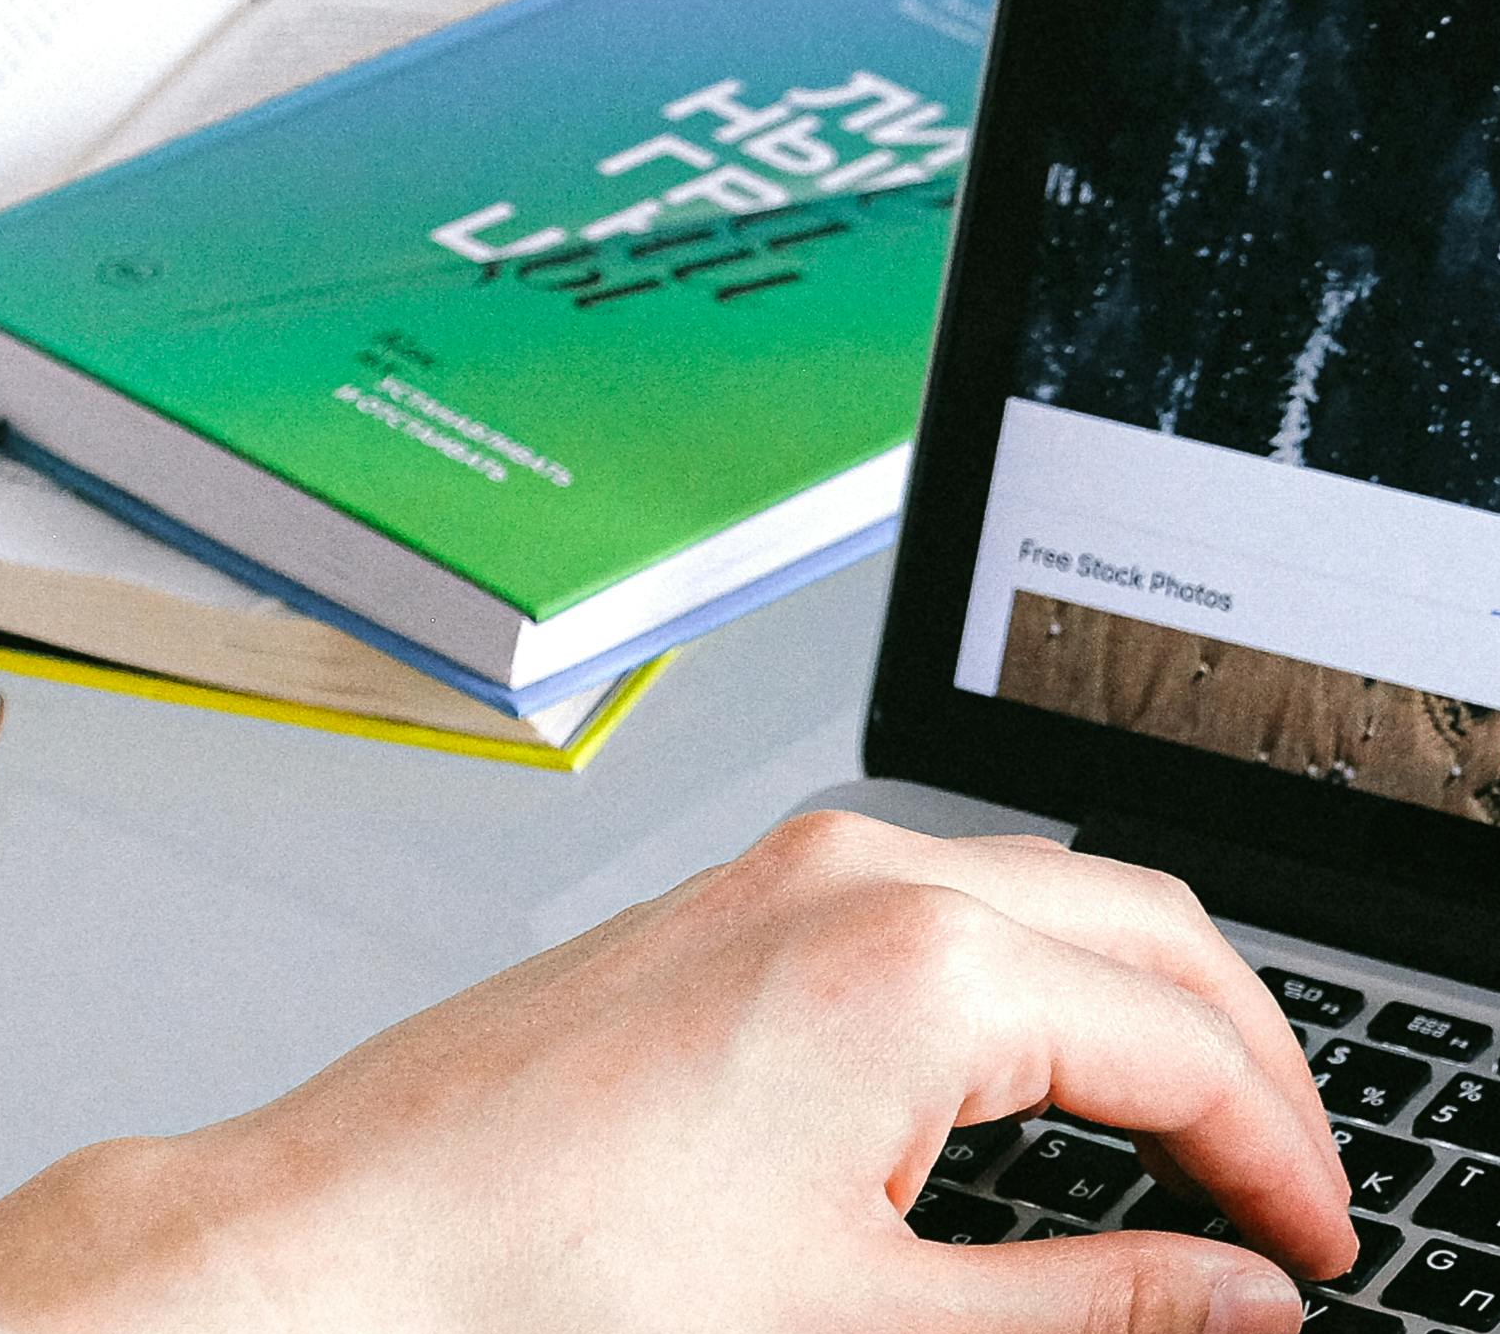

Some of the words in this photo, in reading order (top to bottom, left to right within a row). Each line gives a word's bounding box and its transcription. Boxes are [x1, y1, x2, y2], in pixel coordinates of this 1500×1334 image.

[1017, 537, 1072, 574] Free
[1076, 550, 1146, 591] Stock
[1148, 567, 1235, 614] Photos
[1361, 1086, 1386, 1106] %
[1458, 1080, 1484, 1102] %
[1431, 1105, 1458, 1122] 5
[944, 1144, 974, 1161] Ф
[1039, 1139, 1067, 1159] S
[1460, 1166, 1485, 1186] T
[1067, 1178, 1105, 1200] Ы
[1425, 1249, 1458, 1270] G
[1459, 1289, 1495, 1311] П
